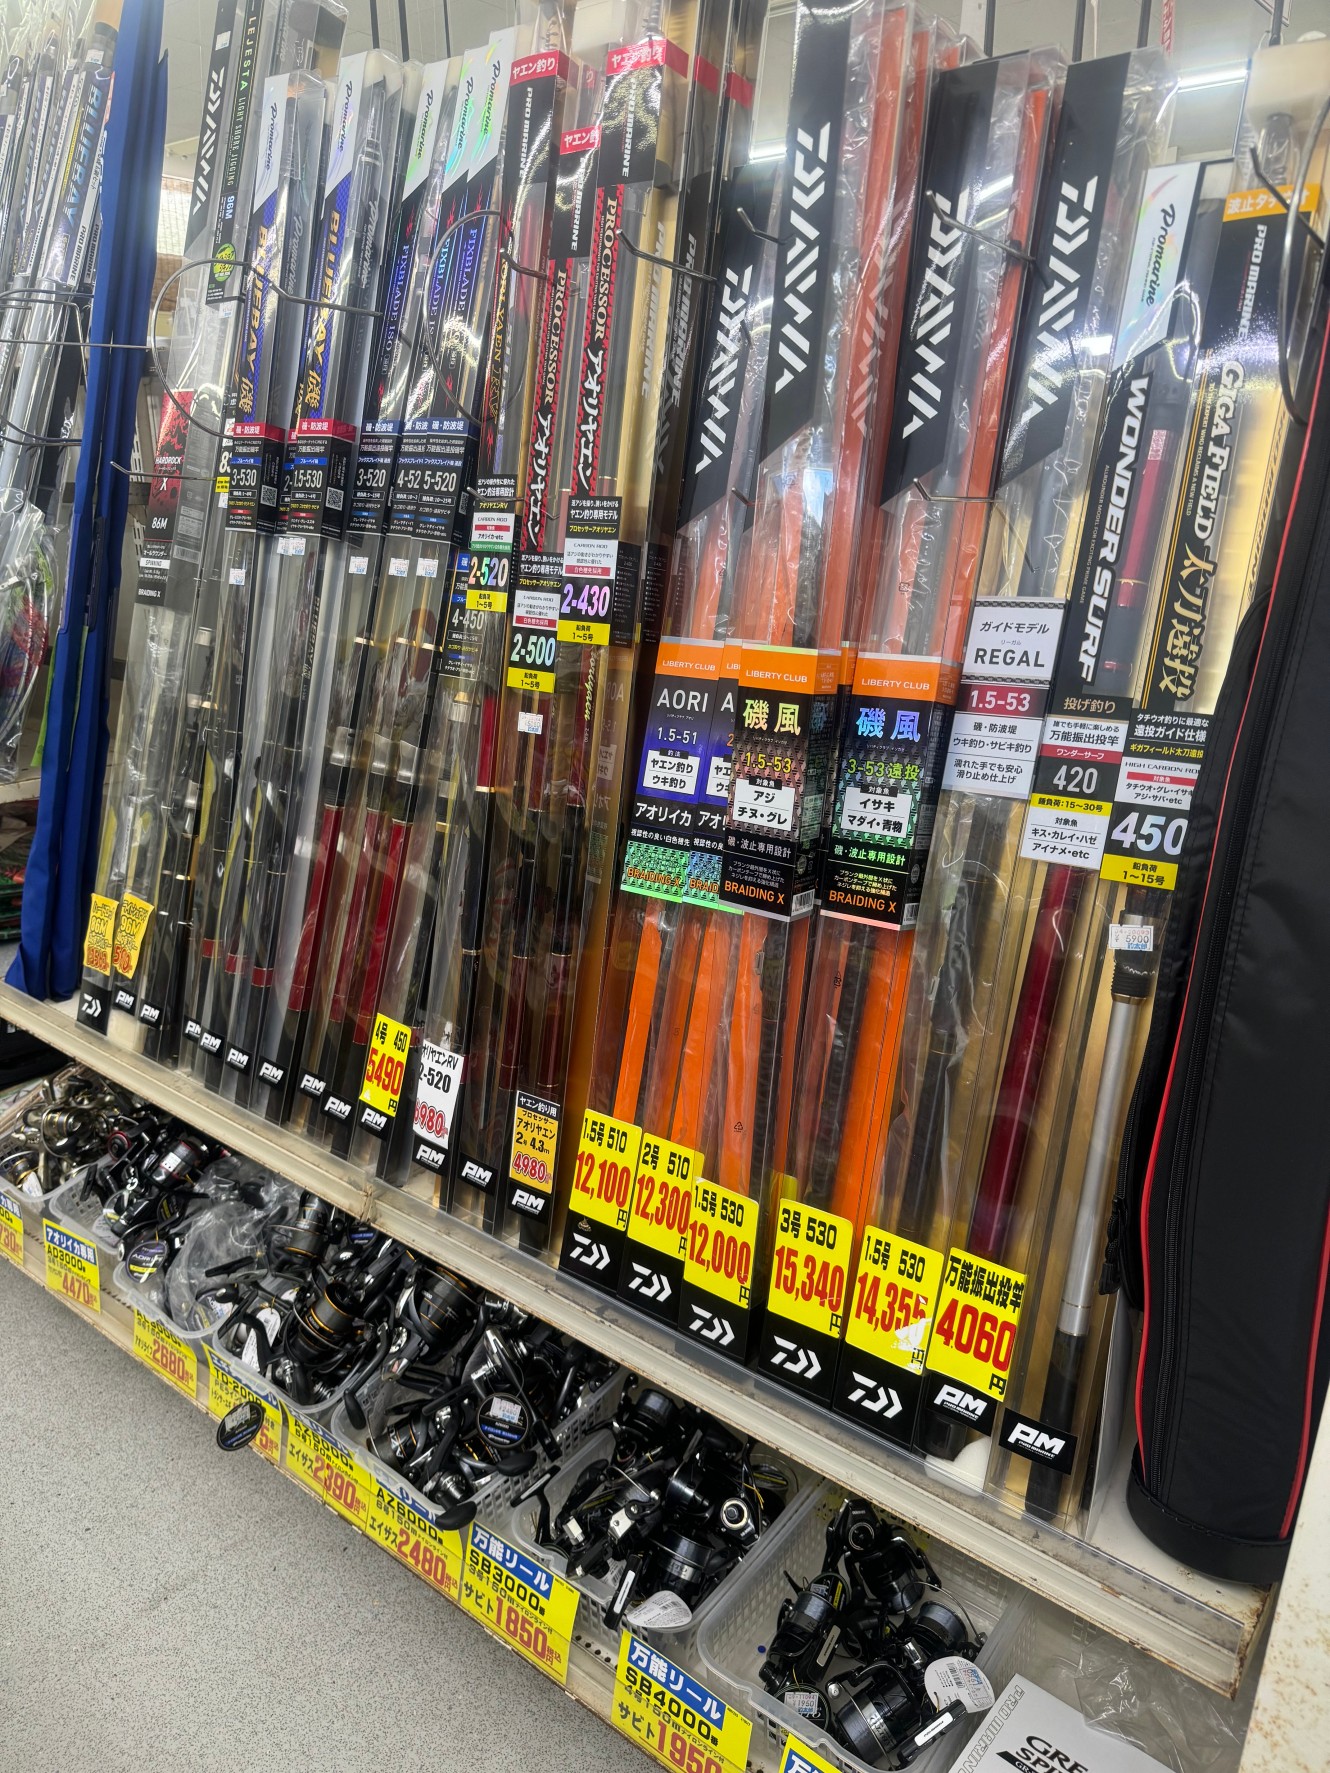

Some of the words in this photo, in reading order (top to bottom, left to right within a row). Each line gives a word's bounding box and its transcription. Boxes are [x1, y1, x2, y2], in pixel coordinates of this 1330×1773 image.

[240, 16, 257, 91] LEJESTA
[512, 57, 555, 80] ヤエン釣り
[483, 60, 500, 135] Promarine
[339, 80, 353, 153] Promarine
[417, 89, 433, 160] Promarine
[457, 77, 473, 150] Promarine
[225, 195, 235, 220] 96M
[1146, 203, 1176, 307] Promarine
[1251, 224, 1267, 263] PRO
[458, 229, 478, 311] FIXBLADE
[595, 198, 618, 341] PROCESSOR
[390, 244, 410, 321] FIXBLADE
[1238, 265, 1260, 340] MARINE
[545, 268, 567, 406] PROCESSOR
[1214, 361, 1245, 437] GIGA
[365, 423, 394, 432] 磯・防波堤
[432, 421, 464, 431] 磯・防波堤
[578, 347, 604, 490] アオリヤエン
[155, 456, 182, 465] HARDROCK
[1100, 377, 1149, 565] WONDER
[231, 468, 257, 487] 3-530
[294, 470, 323, 488] 1.5-530
[357, 469, 386, 488] 3-520
[423, 471, 457, 492] 5-520
[528, 411, 553, 545] アオリヤエン
[1195, 440, 1229, 539] FIELD
[151, 517, 168, 530] 86M
[570, 509, 618, 520] ヤエン釣り専用モデル
[569, 525, 617, 534] プロセッサーアオリヤエン
[468, 557, 509, 587] 2-520
[560, 583, 610, 618] 2-430
[452, 609, 485, 631] 4-450
[979, 621, 1050, 635] ガイドモデル
[1078, 566, 1113, 682] SURF
[572, 632, 594, 642] 1〜5号
[510, 633, 556, 667] 2-500
[974, 647, 1045, 668] REGAL
[662, 660, 694, 670] LIBERTY
[695, 663, 716, 671] CLUB
[746, 669, 783, 681] LIBERTY
[784, 673, 808, 684] CLUB
[861, 678, 901, 688] LIBERTY
[903, 681, 930, 691] CLUB
[656, 687, 709, 713] AORI
[971, 690, 1031, 712] 1.5-53
[1063, 697, 1116, 714] 投げ釣り
[743, 699, 801, 736] 磯風
[856, 707, 921, 743] 磯風
[973, 722, 1018, 735] 磯・防波堤
[1053, 720, 1120, 733] 誰でも手軽に楽しめる
[1136, 713, 1210, 728] タチウオ釣りに最適な
[657, 727, 698, 745] 1.5-51
[953, 737, 1032, 754] ウキ釣り・サビキ釣り
[1049, 730, 1119, 747] 万能振出投竿
[1134, 725, 1207, 743] 遠投ガイド仕様
[746, 752, 792, 774] 1.5-53
[1056, 748, 1105, 760] ワンダーサーフ
[1130, 743, 1204, 759] ギガフィールド太刀遠投
[650, 758, 694, 775] ヤエン釣り
[847, 758, 920, 781] 3-53遠投
[954, 758, 1023, 775] 濡れた手でも安心
[956, 769, 1017, 785] 滑り止め仕上げ
[1125, 761, 1146, 769] HIGH
[1147, 764, 1183, 773] CARBON
[652, 774, 687, 790] ウキ釣り
[755, 777, 776, 788] 対象魚
[868, 786, 890, 795] 対象魚
[1052, 764, 1098, 795] 420
[753, 789, 776, 803] アジ
[859, 798, 896, 813] イサキ
[1134, 792, 1183, 805] アジ・サバ・etc
[635, 802, 692, 828] アオリイカ
[737, 806, 788, 826] チヌ・グレ
[847, 815, 904, 834] マダイ・青物
[1054, 817, 1078, 828] 対象魚
[631, 828, 690, 848] 視認性の良い白色穂先
[1031, 828, 1098, 846] キス・カレイ・ハゼ
[1111, 811, 1188, 856] 450
[728, 836, 792, 860] 磯・波止専用設計
[834, 845, 906, 867] 磯・波止専用設計
[1032, 842, 1090, 860] アイナメ・etc
[627, 867, 674, 887] BRAIDING
[1122, 870, 1166, 887] 1〜15号
[1133, 862, 1158, 874] 鉛負荷
[724, 881, 774, 903] BRAIDING
[829, 890, 885, 912] BRAIDING
[888, 901, 897, 914] X
[1125, 935, 1149, 944] 5900
[375, 1021, 388, 1045] 4号
[393, 1029, 408, 1053] 450
[420, 1062, 452, 1094] 2-520
[388, 1098, 399, 1113] 円
[519, 1096, 557, 1117] ヤエン釣り用
[522, 1110, 554, 1125] プロセッサー
[516, 1117, 556, 1140] アオリヤエン
[584, 1118, 605, 1147] 1.5号
[607, 1127, 628, 1154] 510
[530, 1137, 550, 1155] 4.3m
[642, 1143, 660, 1171] 2号
[667, 1151, 691, 1181] 510
[575, 1151, 631, 1209] 12,100
[634, 1174, 692, 1235] 12,300
[694, 1185, 718, 1218] 1.5号
[720, 1197, 744, 1228] 530
[780, 1208, 801, 1239] 3号
[806, 1218, 838, 1250] 530
[46, 1227, 95, 1264] アオリイカ専用
[689, 1220, 751, 1285] 12,000
[864, 1236, 892, 1271] 1.5号
[898, 1249, 925, 1283] 530
[62, 1273, 90, 1303] 4470
[775, 1245, 845, 1314] 15,340
[945, 1255, 1025, 1314] 万能振出投竿
[936, 1298, 1017, 1372] 4060
[153, 1338, 186, 1380] 2680
[989, 1373, 1008, 1398] 円
[289, 1443, 314, 1474] エイザス
[313, 1454, 357, 1509] 2390
[369, 1516, 398, 1548] エイザス
[397, 1528, 446, 1587] 2480
[473, 1526, 550, 1593] 万能リール
[470, 1549, 545, 1616] SB3000番
[464, 1581, 494, 1615] サビト
[495, 1597, 548, 1661] 1850
[631, 1641, 722, 1720] 万能リール
[626, 1666, 719, 1747] SB4000番
[1001, 1684, 1025, 1720] PRO
[618, 1702, 655, 1739] サビト
